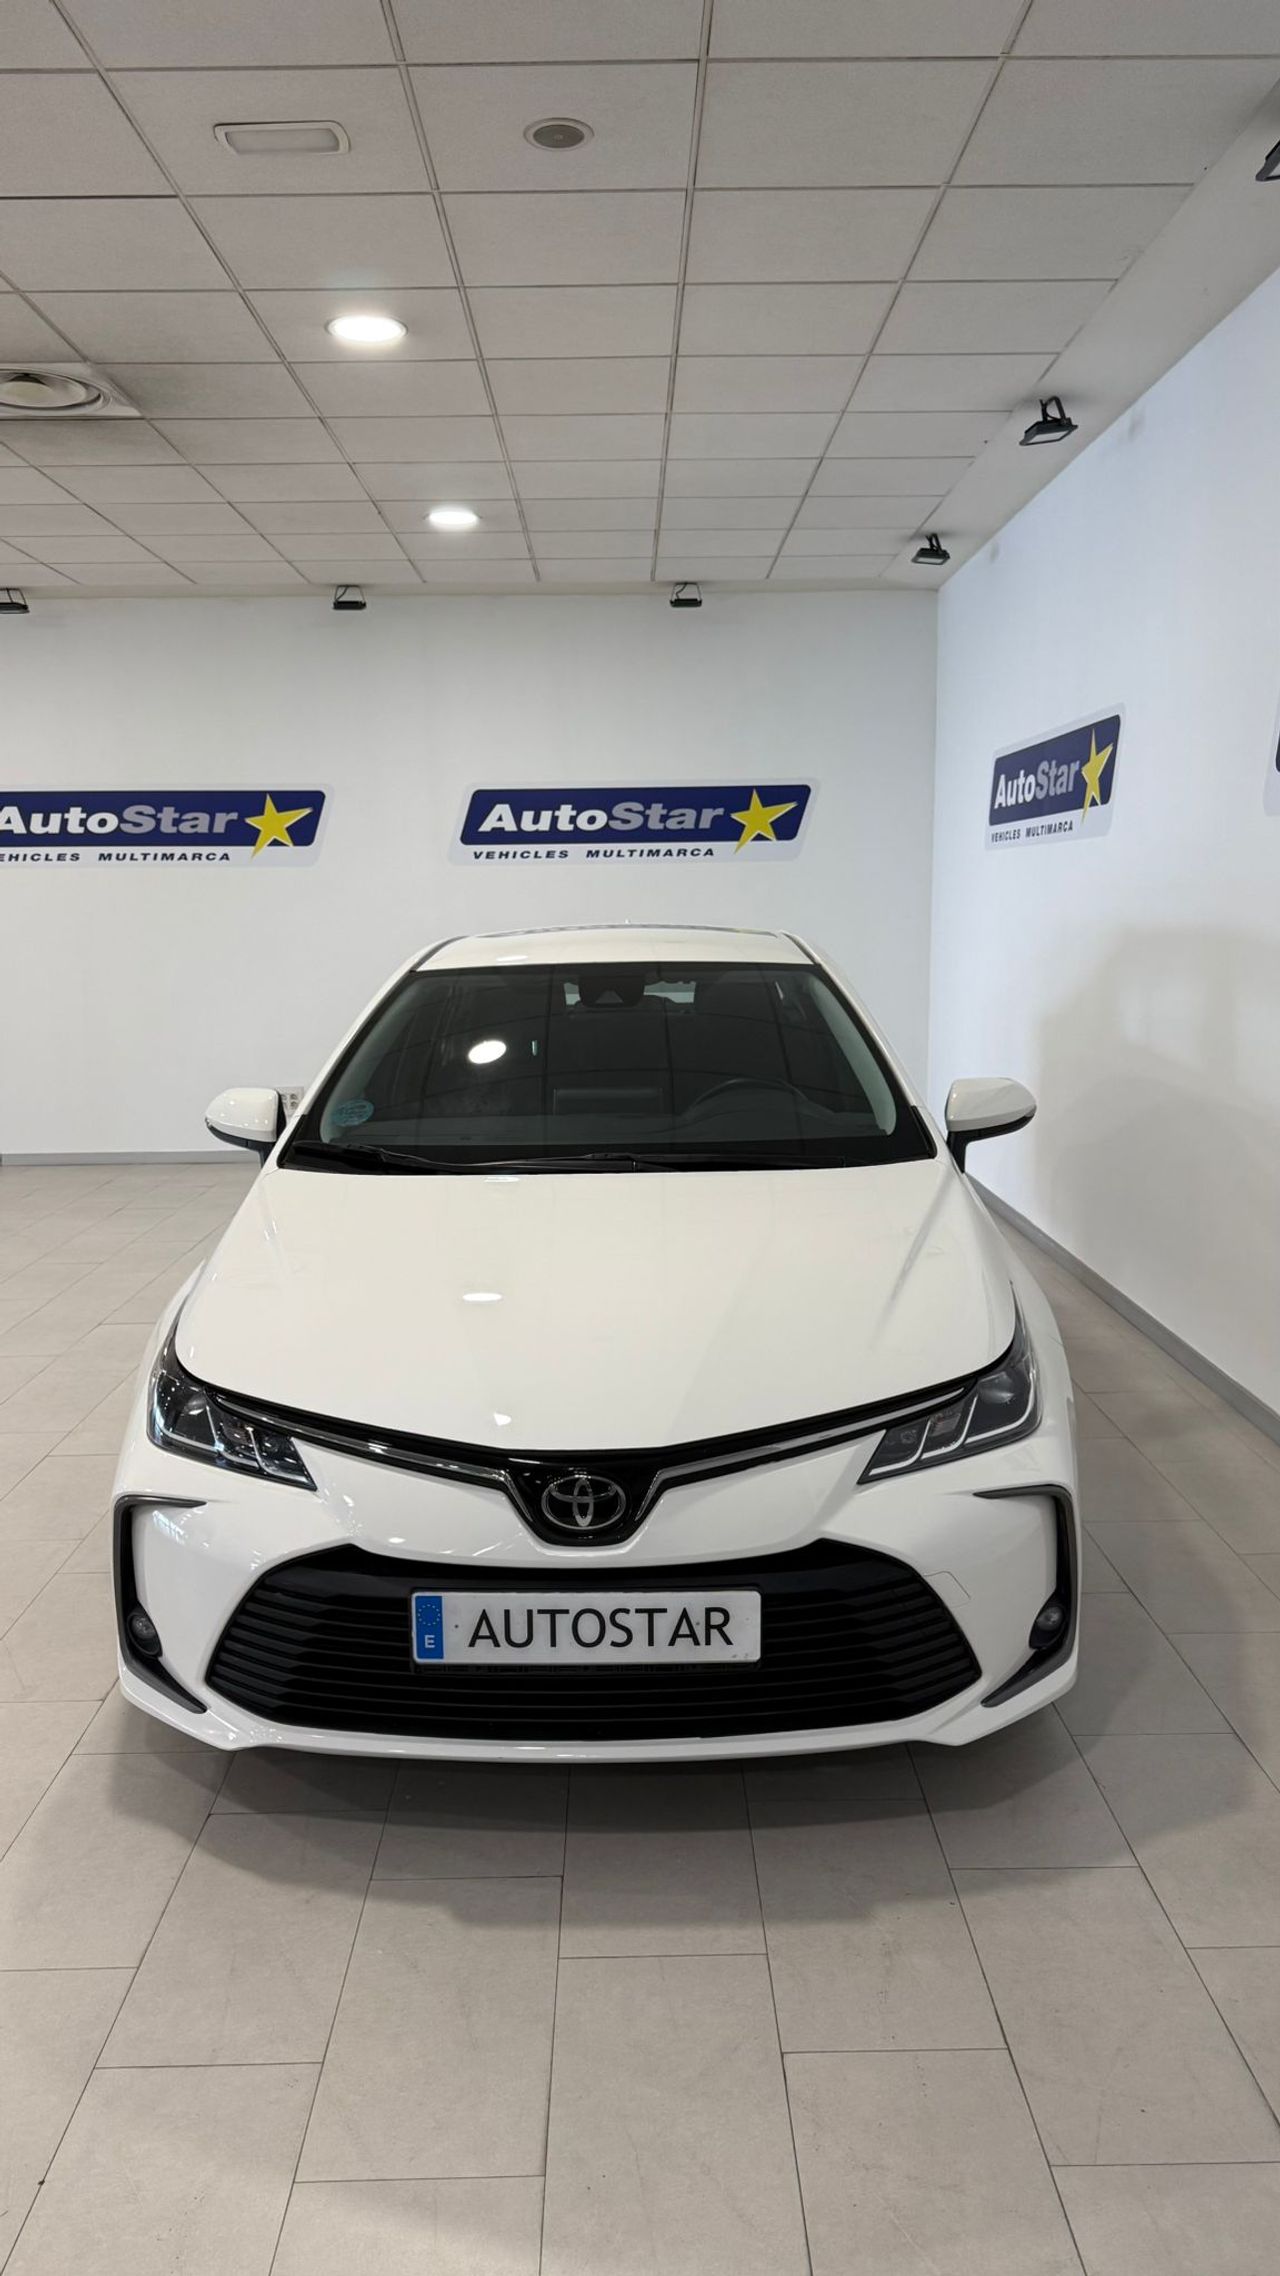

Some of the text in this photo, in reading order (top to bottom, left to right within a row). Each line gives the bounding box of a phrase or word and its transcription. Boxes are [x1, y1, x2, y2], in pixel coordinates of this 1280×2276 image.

[993, 759, 1081, 810] AutoStar
[0, 804, 238, 835] AutoStar
[477, 801, 725, 833] AutoStar
[991, 820, 1074, 843] VEHICLES MULTIMARCA
[98, 852, 231, 862] MULTIMARCA
[473, 847, 715, 860] VEHICLES MULTIMARCA
[468, 1606, 734, 1649] AUTOSTAR
[424, 1634, 436, 1649] E
